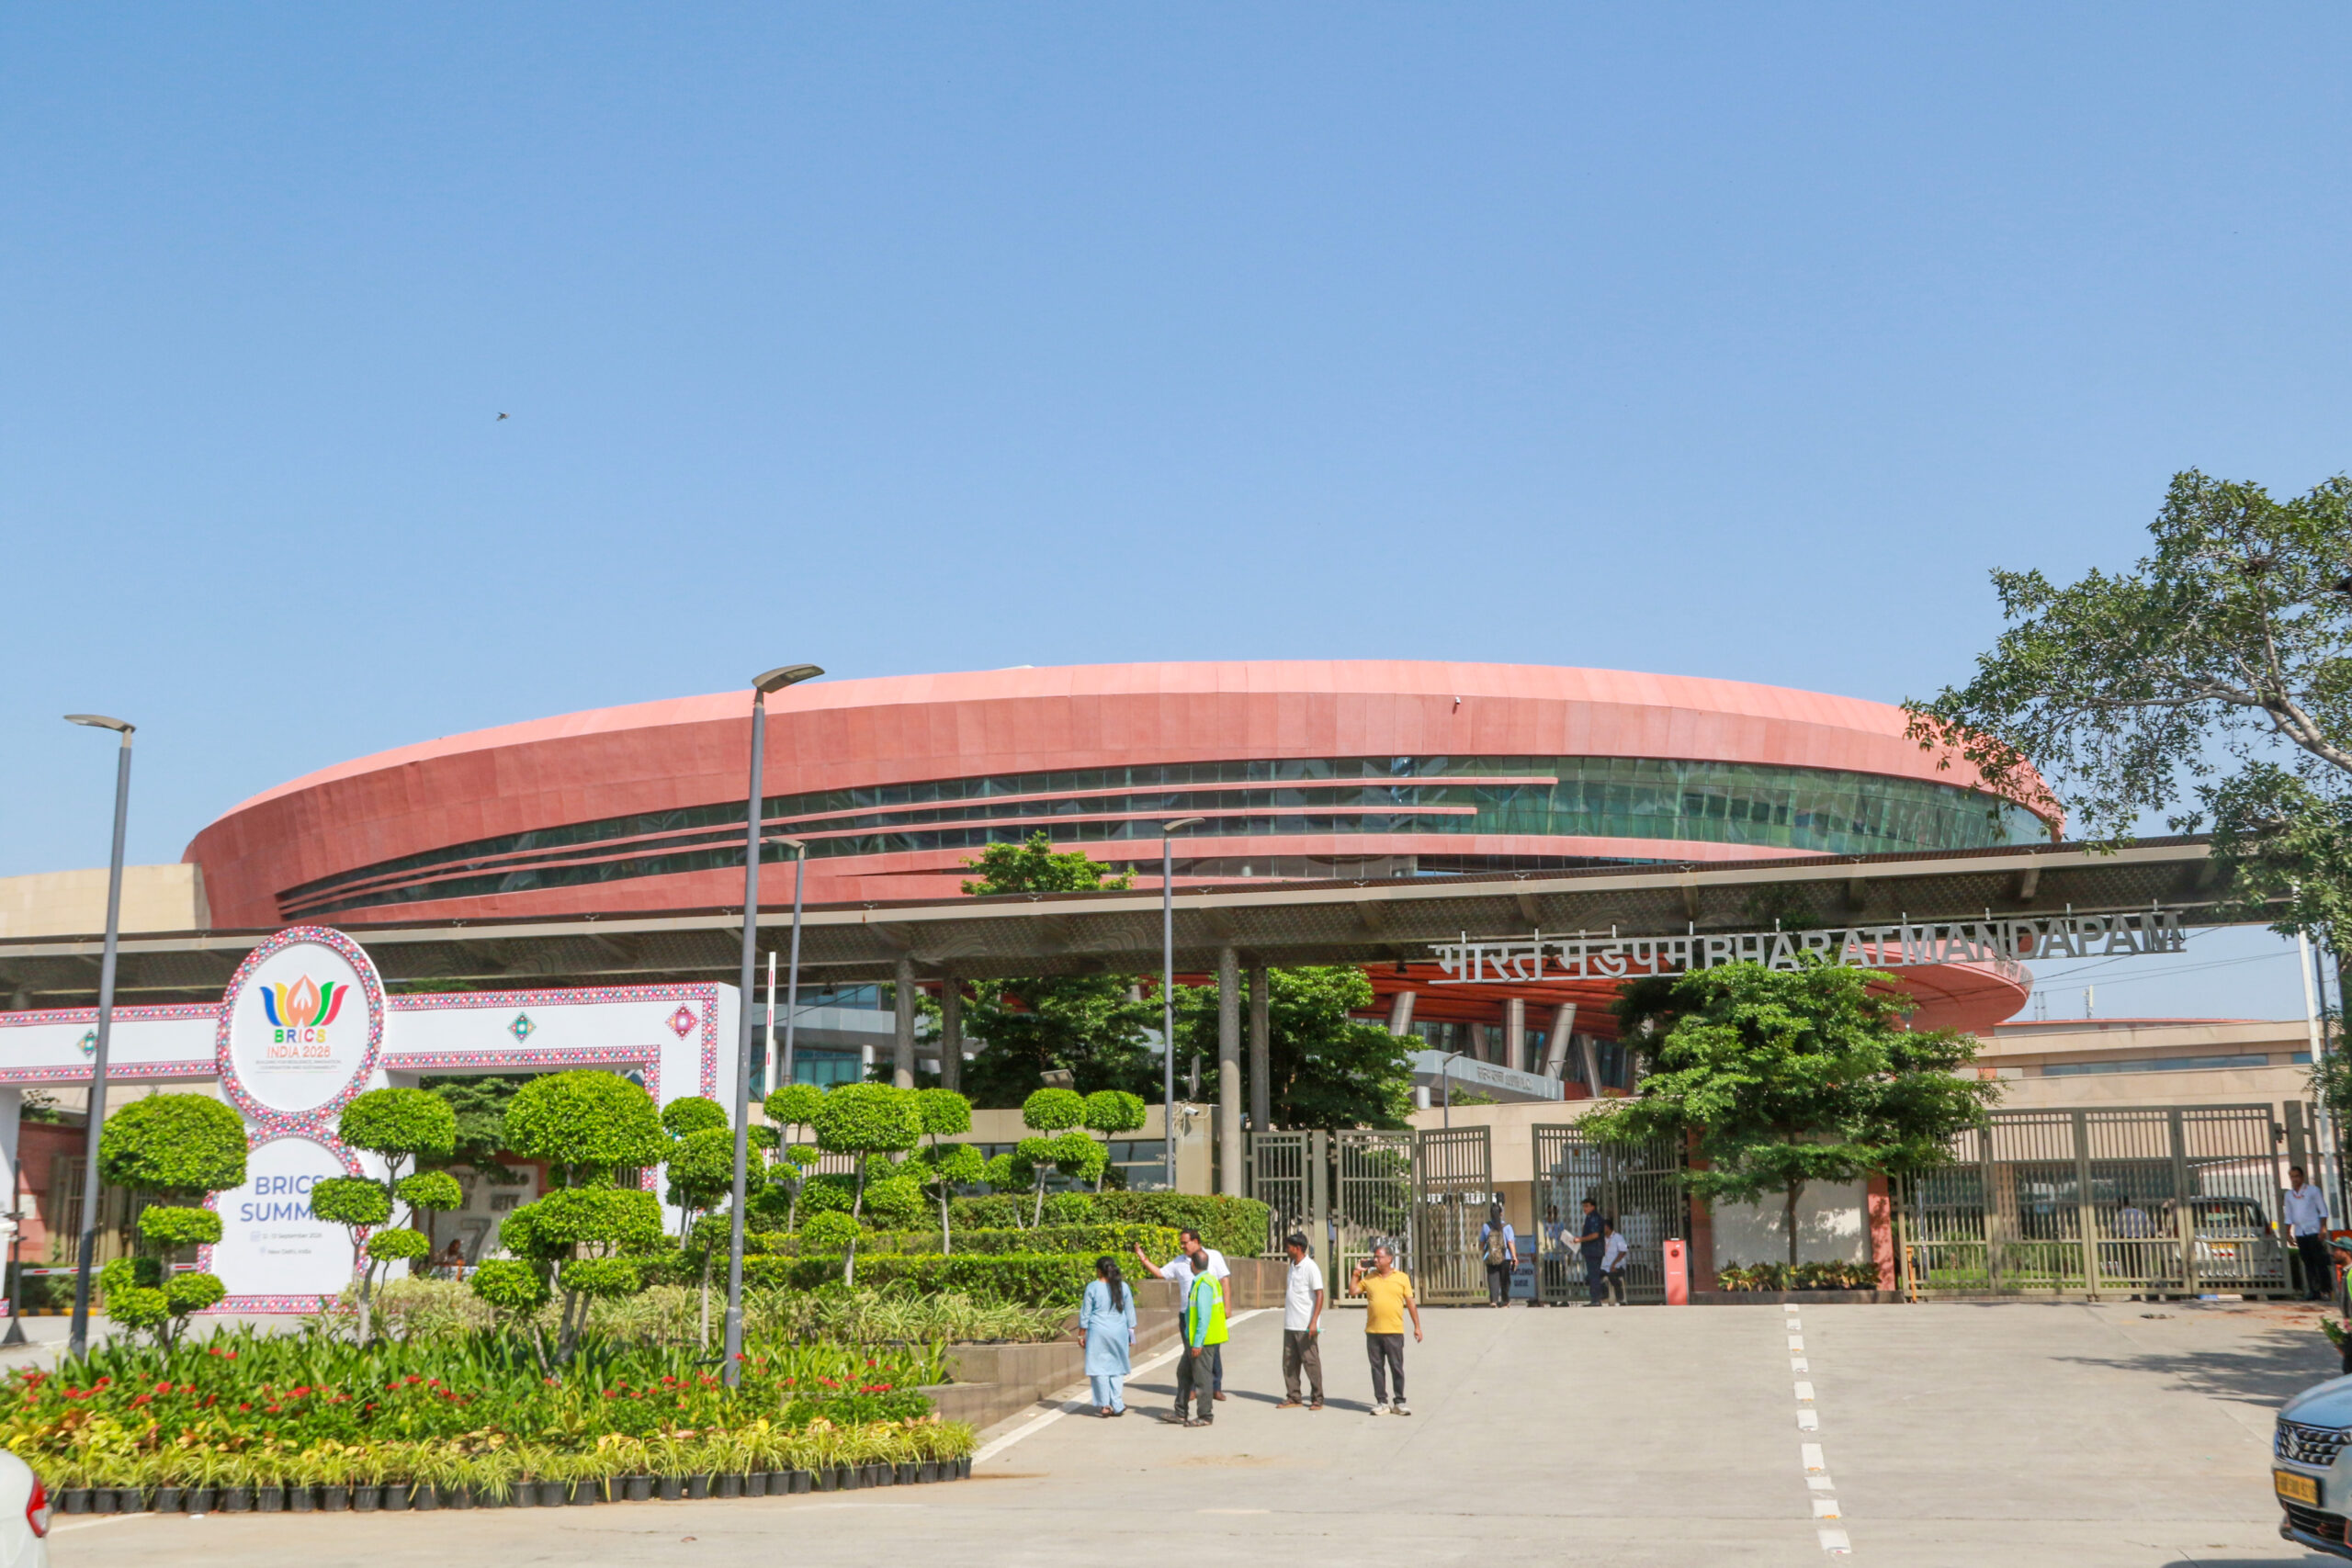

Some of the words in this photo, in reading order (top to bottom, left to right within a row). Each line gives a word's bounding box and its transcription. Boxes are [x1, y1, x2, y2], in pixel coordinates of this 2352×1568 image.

[1703, 927, 1894, 972] BHARAT
[1899, 912, 2183, 966] MANDAPAM
[1428, 942, 1545, 983] भारत
[274, 1028, 326, 1043] BRICS
[266, 1045, 300, 1058] INDIA
[302, 1045, 331, 1058] 2026
[240, 1201, 313, 1222] SUMM
[461, 1218, 492, 1266] 7
